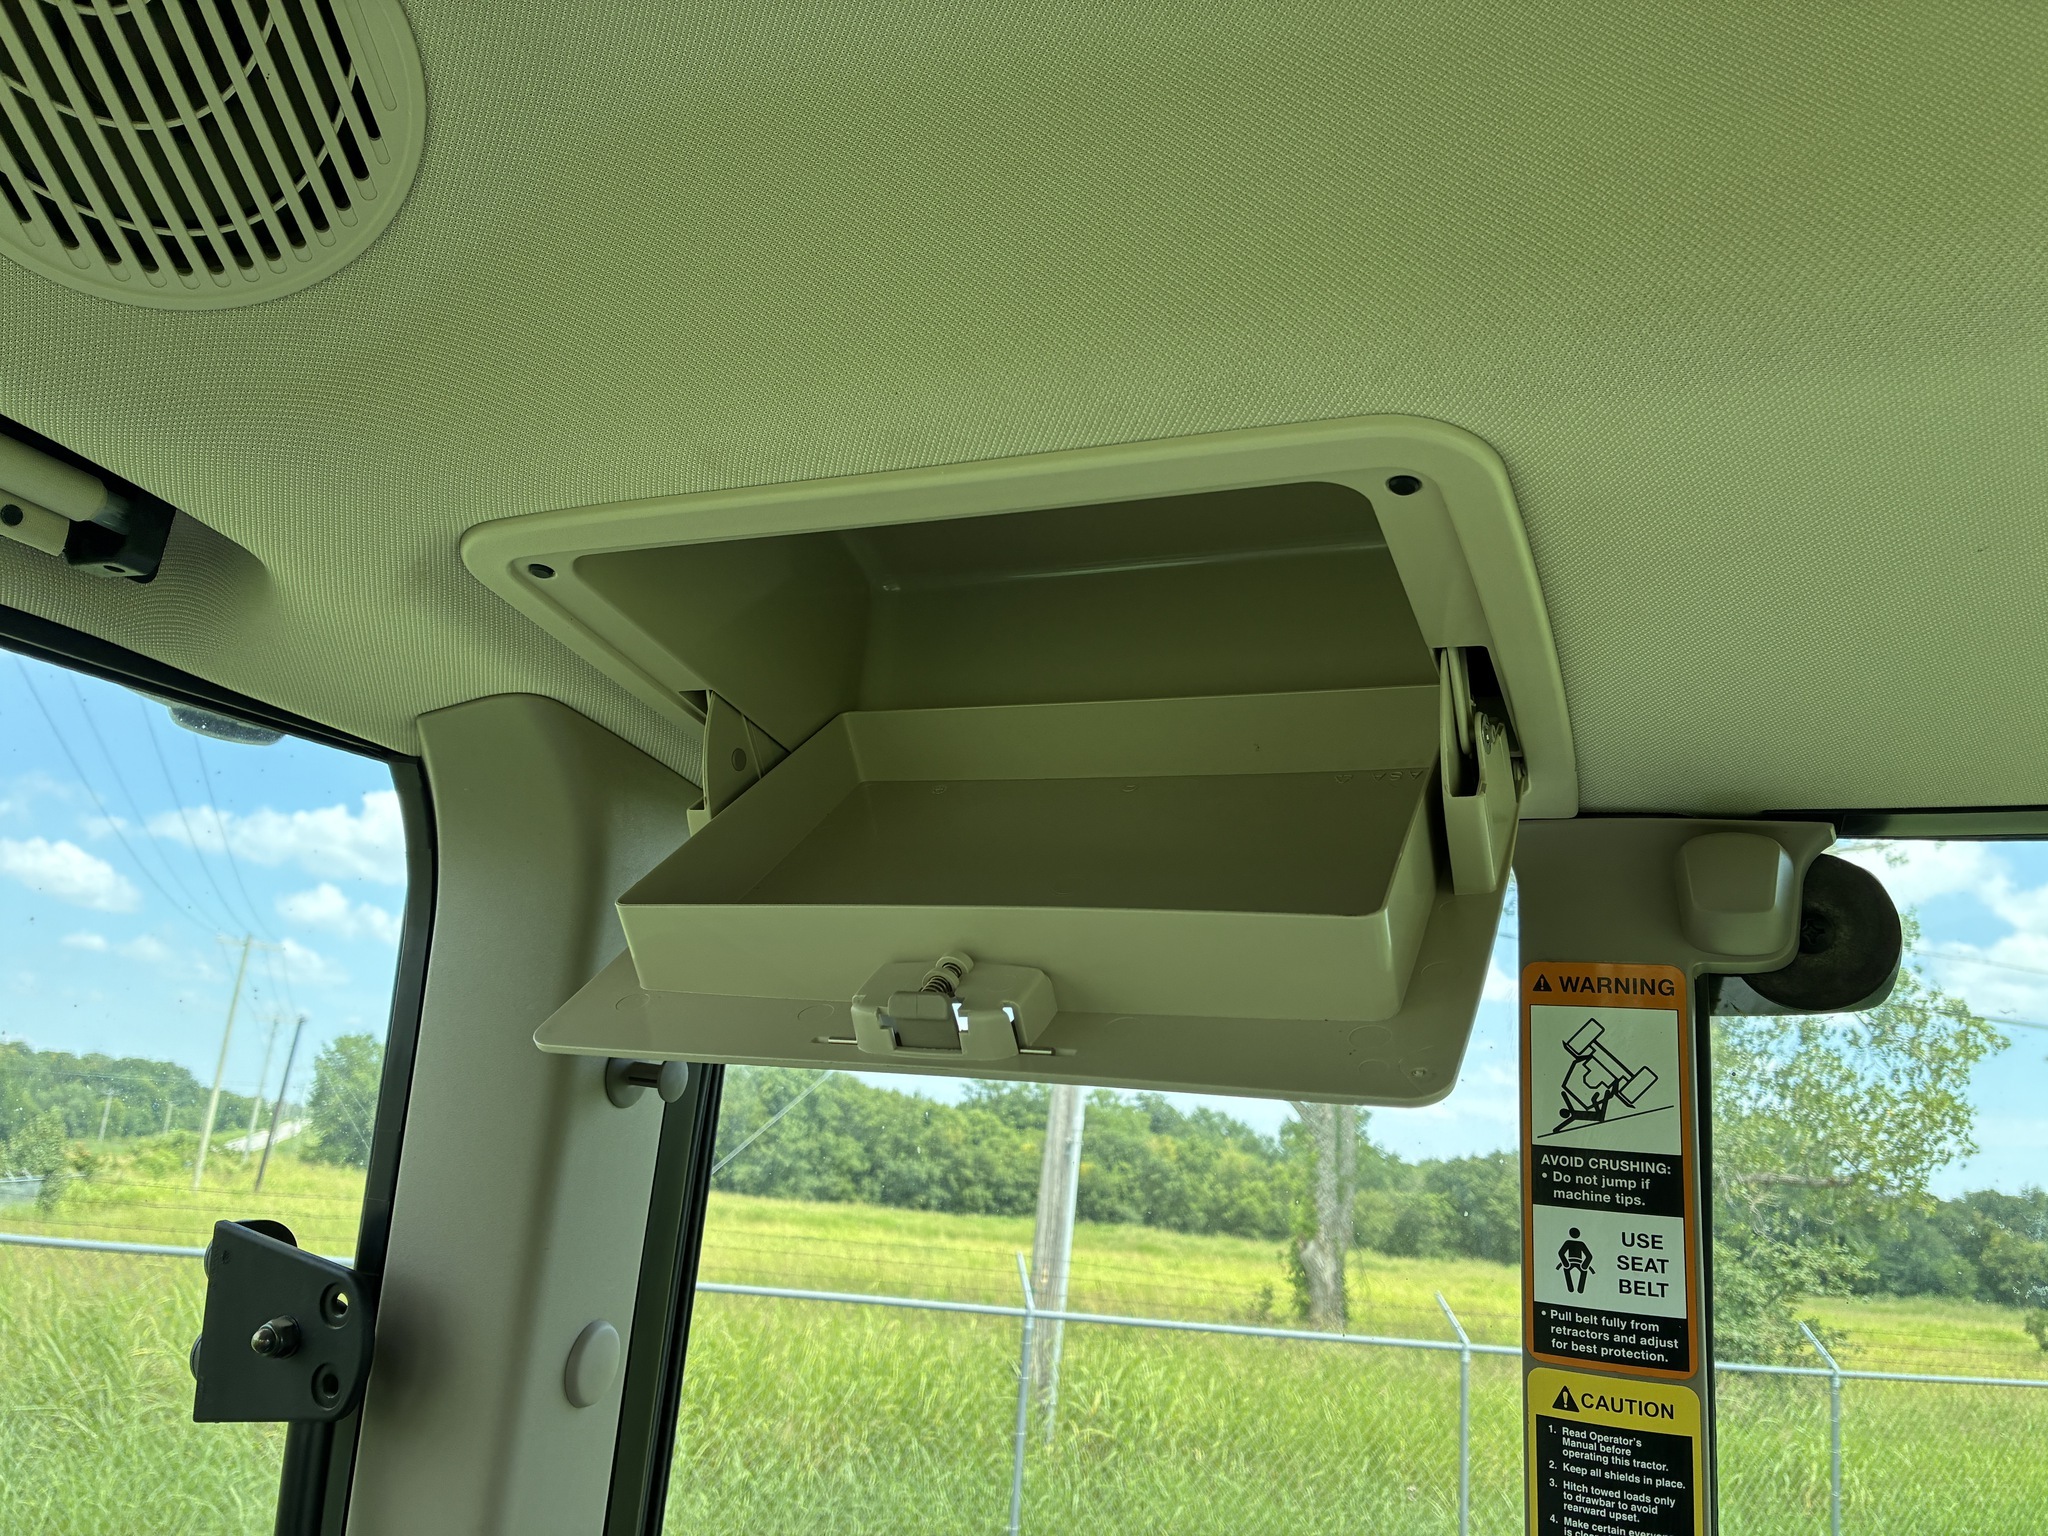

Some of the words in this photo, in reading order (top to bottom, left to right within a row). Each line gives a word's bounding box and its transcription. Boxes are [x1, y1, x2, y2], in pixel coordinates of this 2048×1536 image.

[1559, 975, 1675, 996] WARNING
[1541, 1154, 1584, 1168] AVOID
[1588, 1157, 1671, 1175] CRUSHING:
[1553, 1171, 1571, 1183] Do
[1575, 1174, 1598, 1186] not
[1600, 1175, 1637, 1190] jump
[1641, 1178, 1650, 1189] if
[1553, 1188, 1611, 1203] machine
[1615, 1192, 1646, 1207] tips.
[1621, 1231, 1663, 1250] USE
[1617, 1255, 1669, 1274] SEAT
[1619, 1279, 1669, 1298] BELT
[1550, 1309, 1572, 1321] Pull
[1575, 1312, 1598, 1325] belt
[1601, 1317, 1627, 1330] fully
[1630, 1320, 1659, 1332] from
[1550, 1325, 1610, 1341] retractors
[1613, 1333, 1636, 1344] and
[1640, 1336, 1679, 1350] adjust
[1551, 1338, 1568, 1350] for
[1571, 1341, 1597, 1354] best
[1601, 1346, 1668, 1362] protection.
[1581, 1393, 1674, 1420] CAUTION
[1548, 1424, 1557, 1434] 1.
[1562, 1426, 1586, 1439] Read
[1589, 1431, 1642, 1448] Operator's
[1562, 1437, 1597, 1451] Manual
[1600, 1443, 1631, 1456] before
[1562, 1449, 1609, 1465] operating
[1611, 1456, 1630, 1466] this
[1633, 1459, 1669, 1472] tractor.
[1549, 1460, 1557, 1470] 2.
[1562, 1462, 1587, 1477] Keep
[1590, 1467, 1602, 1478] all
[1604, 1469, 1640, 1484] shields
[1643, 1475, 1652, 1485] in
[1656, 1477, 1686, 1489] place.
[1549, 1478, 1557, 1487] 3.
[1563, 1480, 1588, 1493] Hitch
[1590, 1485, 1620, 1498] towed
[1623, 1490, 1651, 1503] loads
[1653, 1496, 1676, 1508] only
[1563, 1491, 1573, 1500] to
[1575, 1493, 1615, 1509] drawbar
[1618, 1500, 1628, 1510] to
[1630, 1502, 1658, 1515] avoid
[1563, 1503, 1606, 1517] rearward
[1609, 1510, 1640, 1523] upset.
[1549, 1514, 1558, 1523] 4.
[1564, 1516, 1589, 1529] Make
[1591, 1523, 1626, 1536] certain
